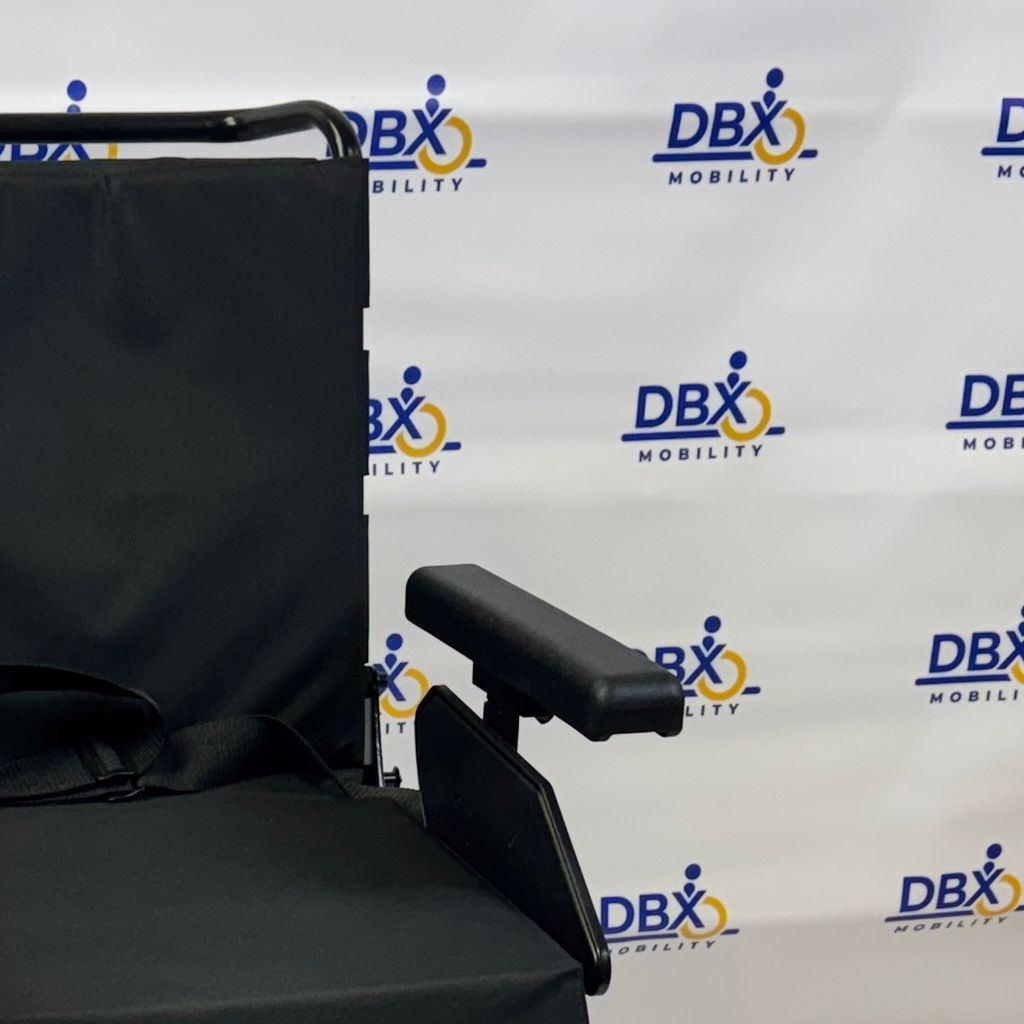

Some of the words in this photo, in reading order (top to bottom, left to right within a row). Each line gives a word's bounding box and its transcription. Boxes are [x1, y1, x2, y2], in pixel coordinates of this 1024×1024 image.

[667, 101, 787, 149] DBX
[372, 177, 464, 193] BILITY
[669, 168, 795, 185] MOBILITY
[960, 374, 1024, 417] DB
[635, 381, 751, 429] DBX
[963, 437, 1024, 450] MOBI
[639, 444, 762, 462] MOBILITY
[373, 460, 440, 476] ILITY
[655, 643, 726, 685] BX
[930, 689, 1018, 704] MOBILI
[686, 703, 741, 717] LITY
[899, 867, 1004, 913] DBX
[601, 889, 706, 934] DBX
[894, 917, 1007, 933] MOBILITY
[618, 940, 716, 954] OBILITY
